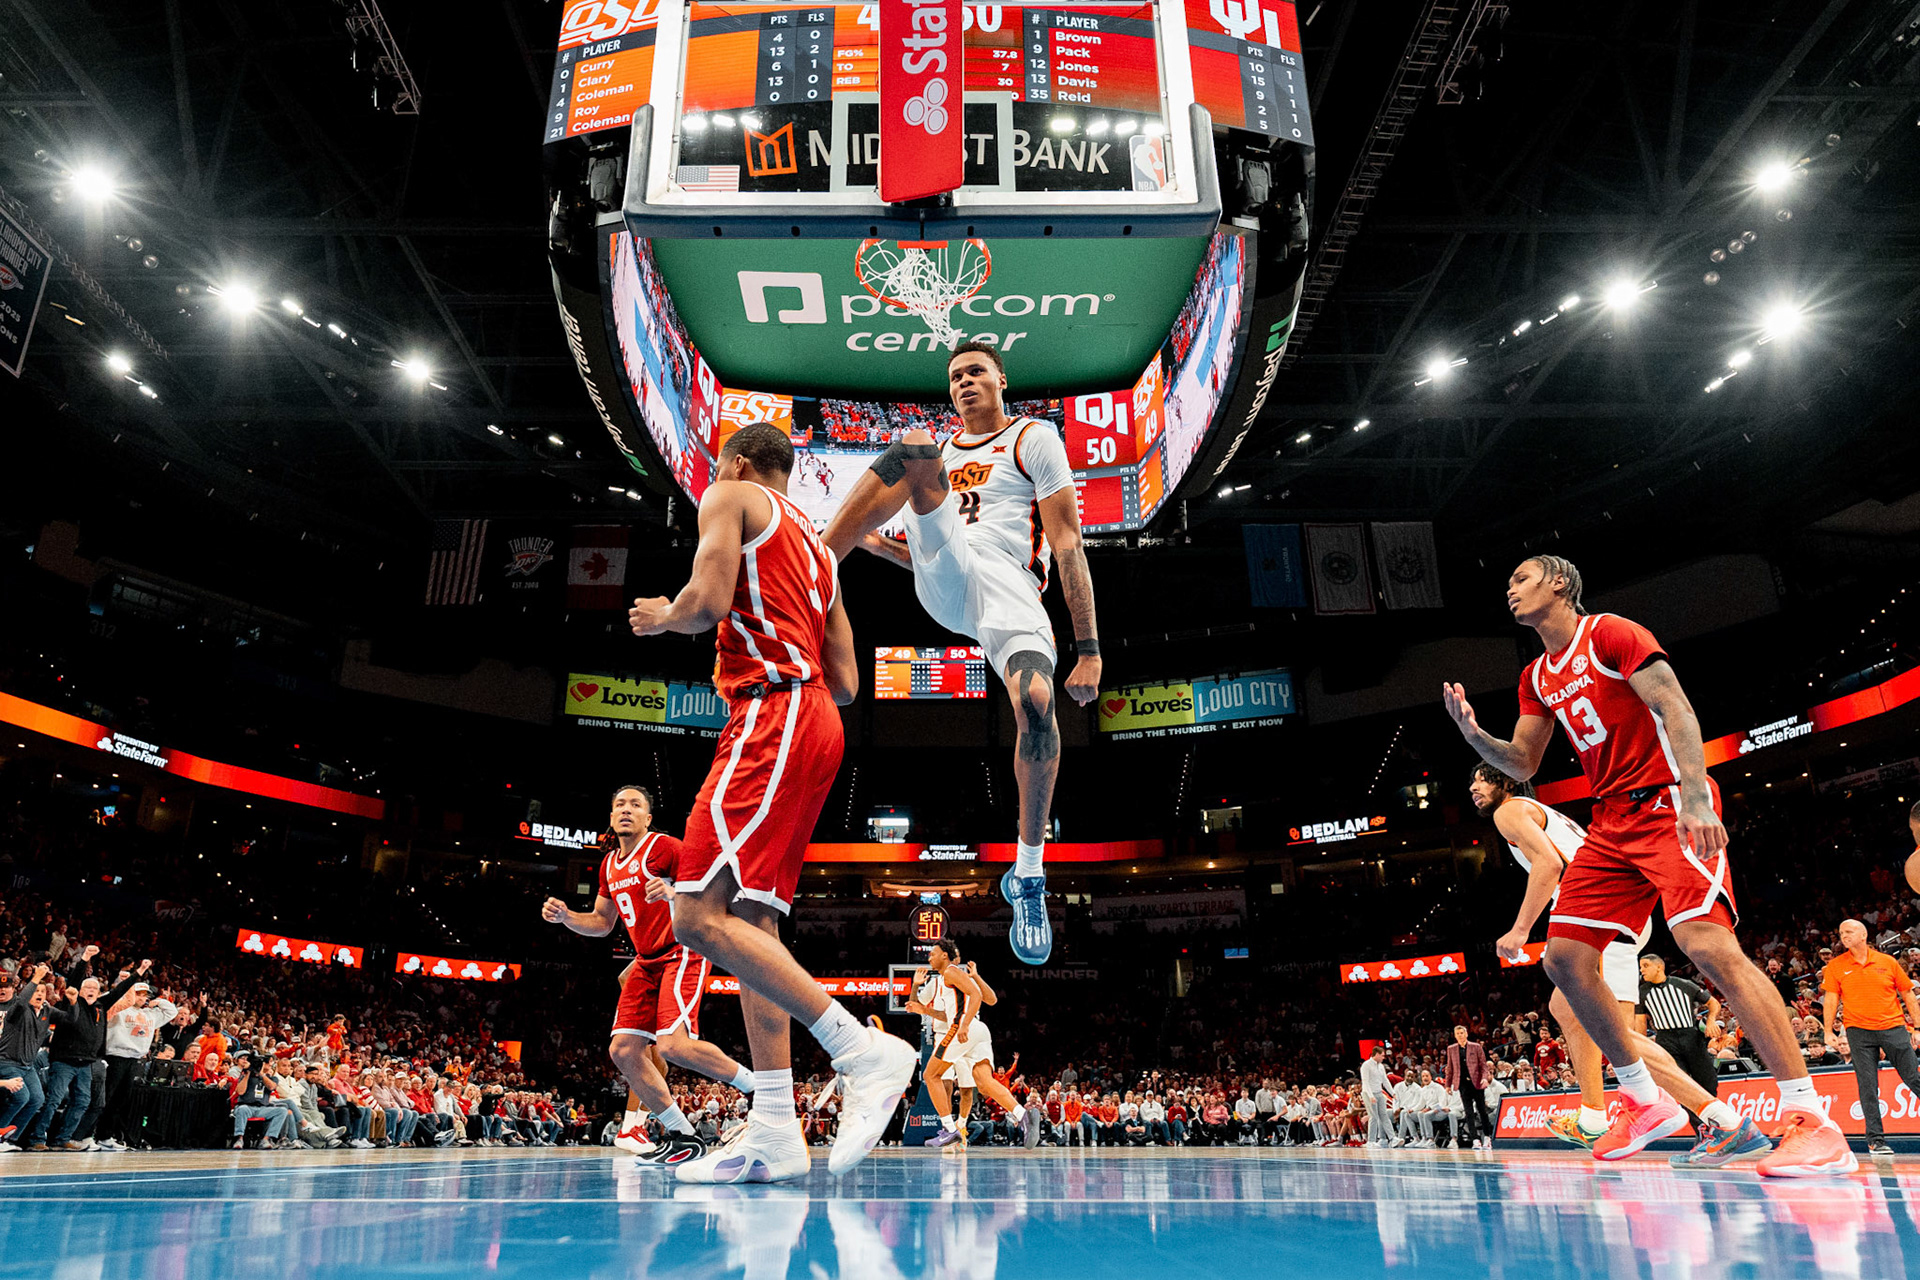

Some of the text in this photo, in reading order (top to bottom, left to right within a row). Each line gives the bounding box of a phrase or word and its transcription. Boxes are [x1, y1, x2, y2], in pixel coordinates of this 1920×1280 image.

[770, 13, 825, 25] PTS FLS
[1056, 16, 1099, 30] PLAYER
[773, 30, 820, 43] 4 0
[1035, 29, 1102, 45] 1 Brown
[583, 40, 621, 58] PLAYER
[769, 45, 819, 57] 13 2
[837, 49, 1018, 59] FG% 37.8
[1034, 44, 1091, 58] 9 Pack
[1247, 46, 1296, 66] PTS FLS
[560, 58, 615, 80] 0 Curry
[772, 59, 817, 72] 6 1
[837, 63, 1009, 71] TO 7
[1030, 59, 1099, 74] 12 Jones
[1248, 62, 1293, 80] 10 1
[561, 74, 612, 93] 1 Clary
[767, 74, 818, 87] 13 0
[836, 77, 1014, 87] REB 30
[1031, 73, 1098, 89] 13 Davis
[1251, 76, 1295, 95] 15 1
[556, 84, 634, 108] 4 Coleman
[769, 89, 818, 102] 0 0
[1030, 88, 1091, 103] 35 Reid
[1256, 90, 1296, 109] 9 1
[554, 105, 600, 123] 9 Roy
[1257, 104, 1299, 124] 2 1
[550, 114, 630, 138] 21 Coleman
[1259, 119, 1302, 138] 5 0
[1013, 128, 1111, 174] BANK
[1138, 181, 1154, 190] NBA
[696, 407, 713, 445] 50
[1144, 409, 1158, 444] 49
[1086, 436, 1117, 466] 50
[958, 491, 981, 525] 4
[507, 536, 555, 555] THUNDER
[894, 649, 911, 659] 49
[950, 649, 967, 659] 50
[670, 692, 716, 719] LOUD
[1198, 682, 1245, 718] LOUD
[1249, 681, 1290, 709] CITY
[577, 718, 611, 728] BRING
[613, 721, 635, 730] THE
[636, 724, 686, 735] THUNDER
[1112, 718, 1283, 741] BRING THE THUNDER EXIT NOW
[1554, 696, 1608, 752] 13
[531, 822, 598, 846] BEDLAM
[1301, 816, 1369, 839] BEDLAM
[544, 838, 584, 849] BASKETBALL
[1316, 832, 1357, 844] BASKETBALL
[616, 891, 637, 928] 9
[917, 921, 942, 940] 30
[1008, 968, 1099, 981] THUNDER
